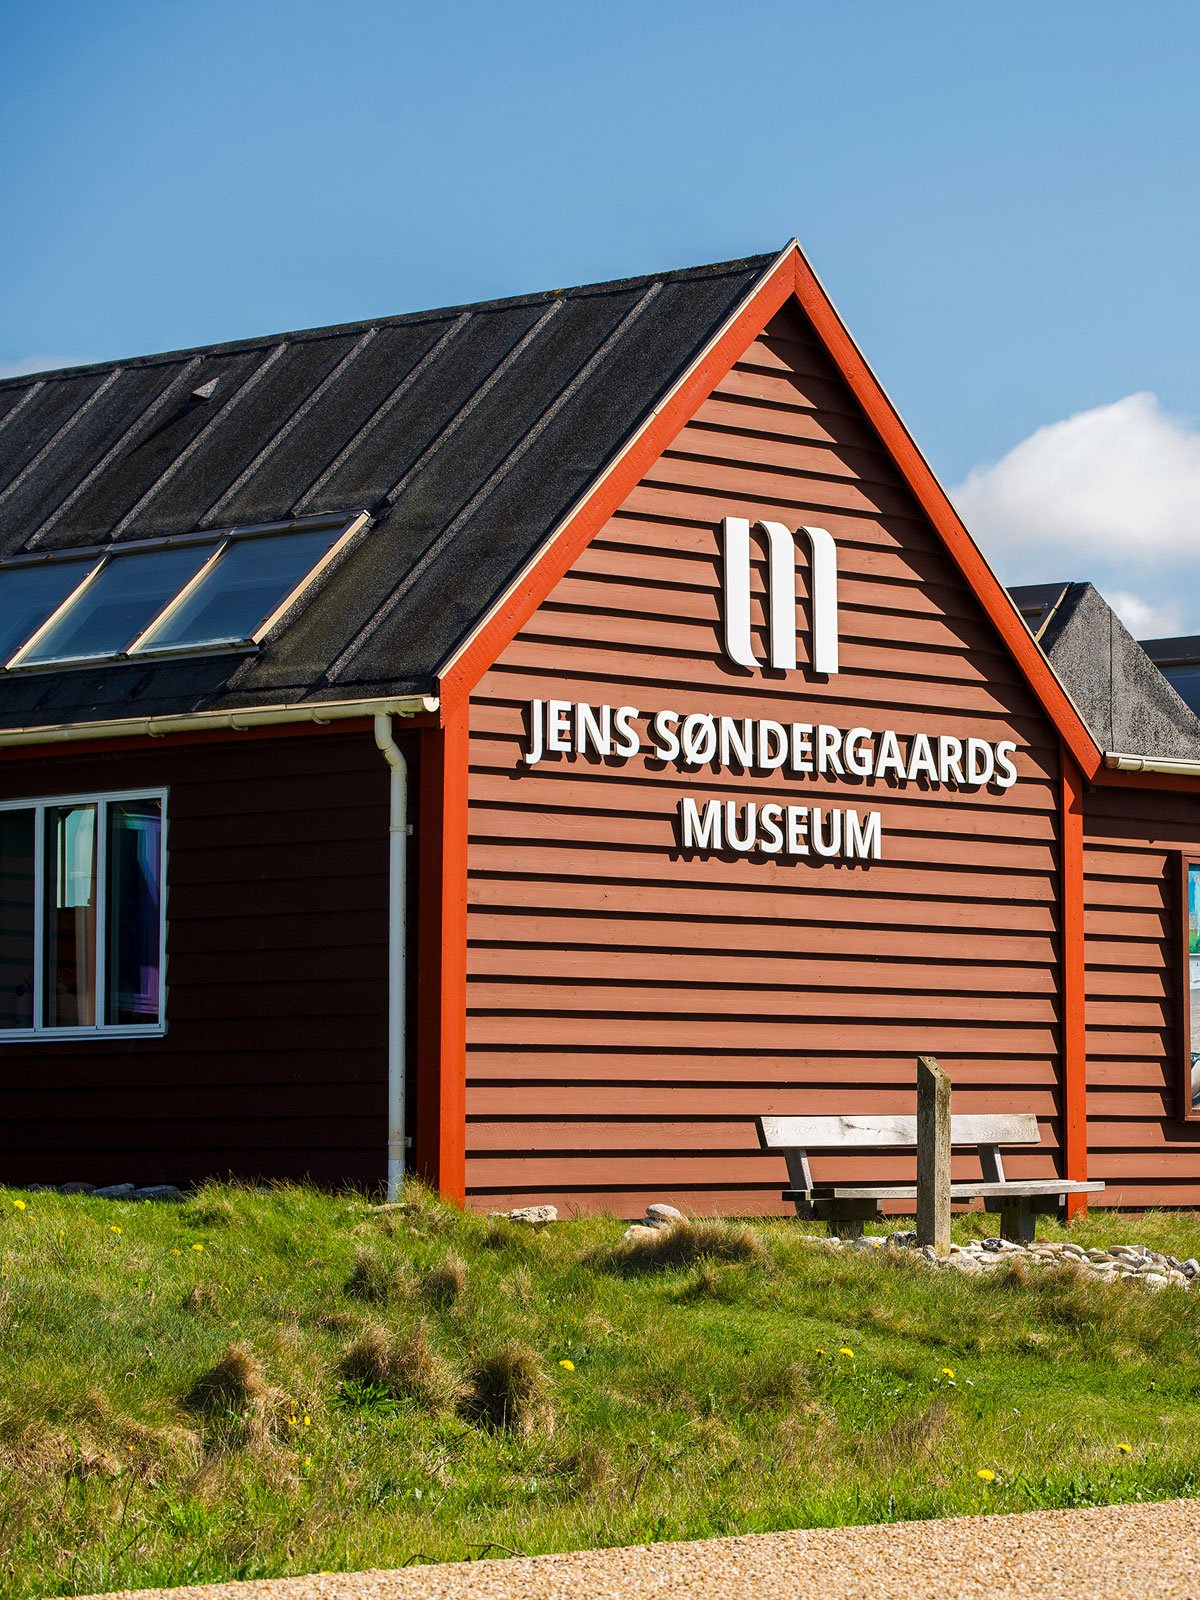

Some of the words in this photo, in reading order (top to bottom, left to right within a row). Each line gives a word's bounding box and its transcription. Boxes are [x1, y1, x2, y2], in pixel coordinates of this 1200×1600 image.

[524, 699, 641, 765] JENS
[654, 710, 1018, 789] SØNDERGAARDS
[681, 797, 882, 861] MUSEUM
